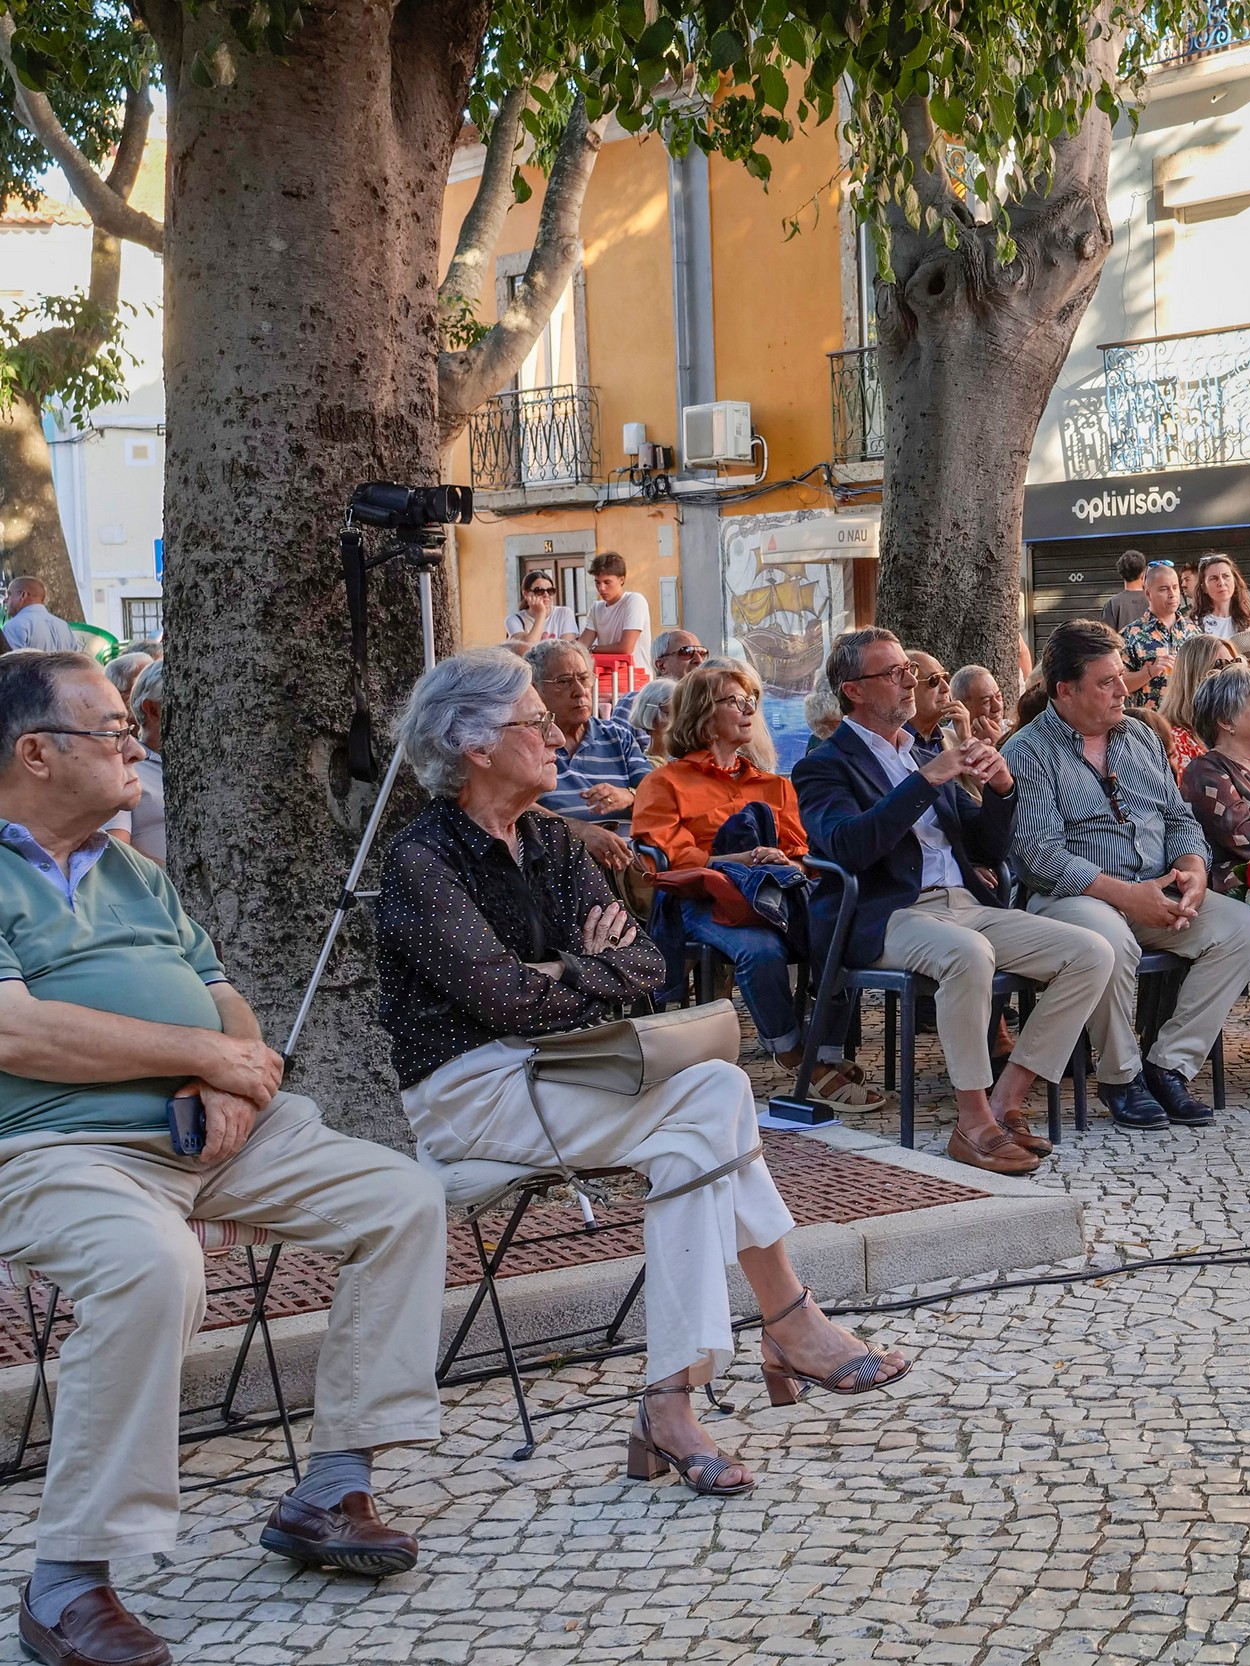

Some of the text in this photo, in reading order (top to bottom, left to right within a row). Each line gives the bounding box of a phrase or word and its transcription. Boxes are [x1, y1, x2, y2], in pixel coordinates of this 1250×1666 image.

[1071, 486, 1181, 524] optivisão
[837, 529, 868, 543] O NAU
